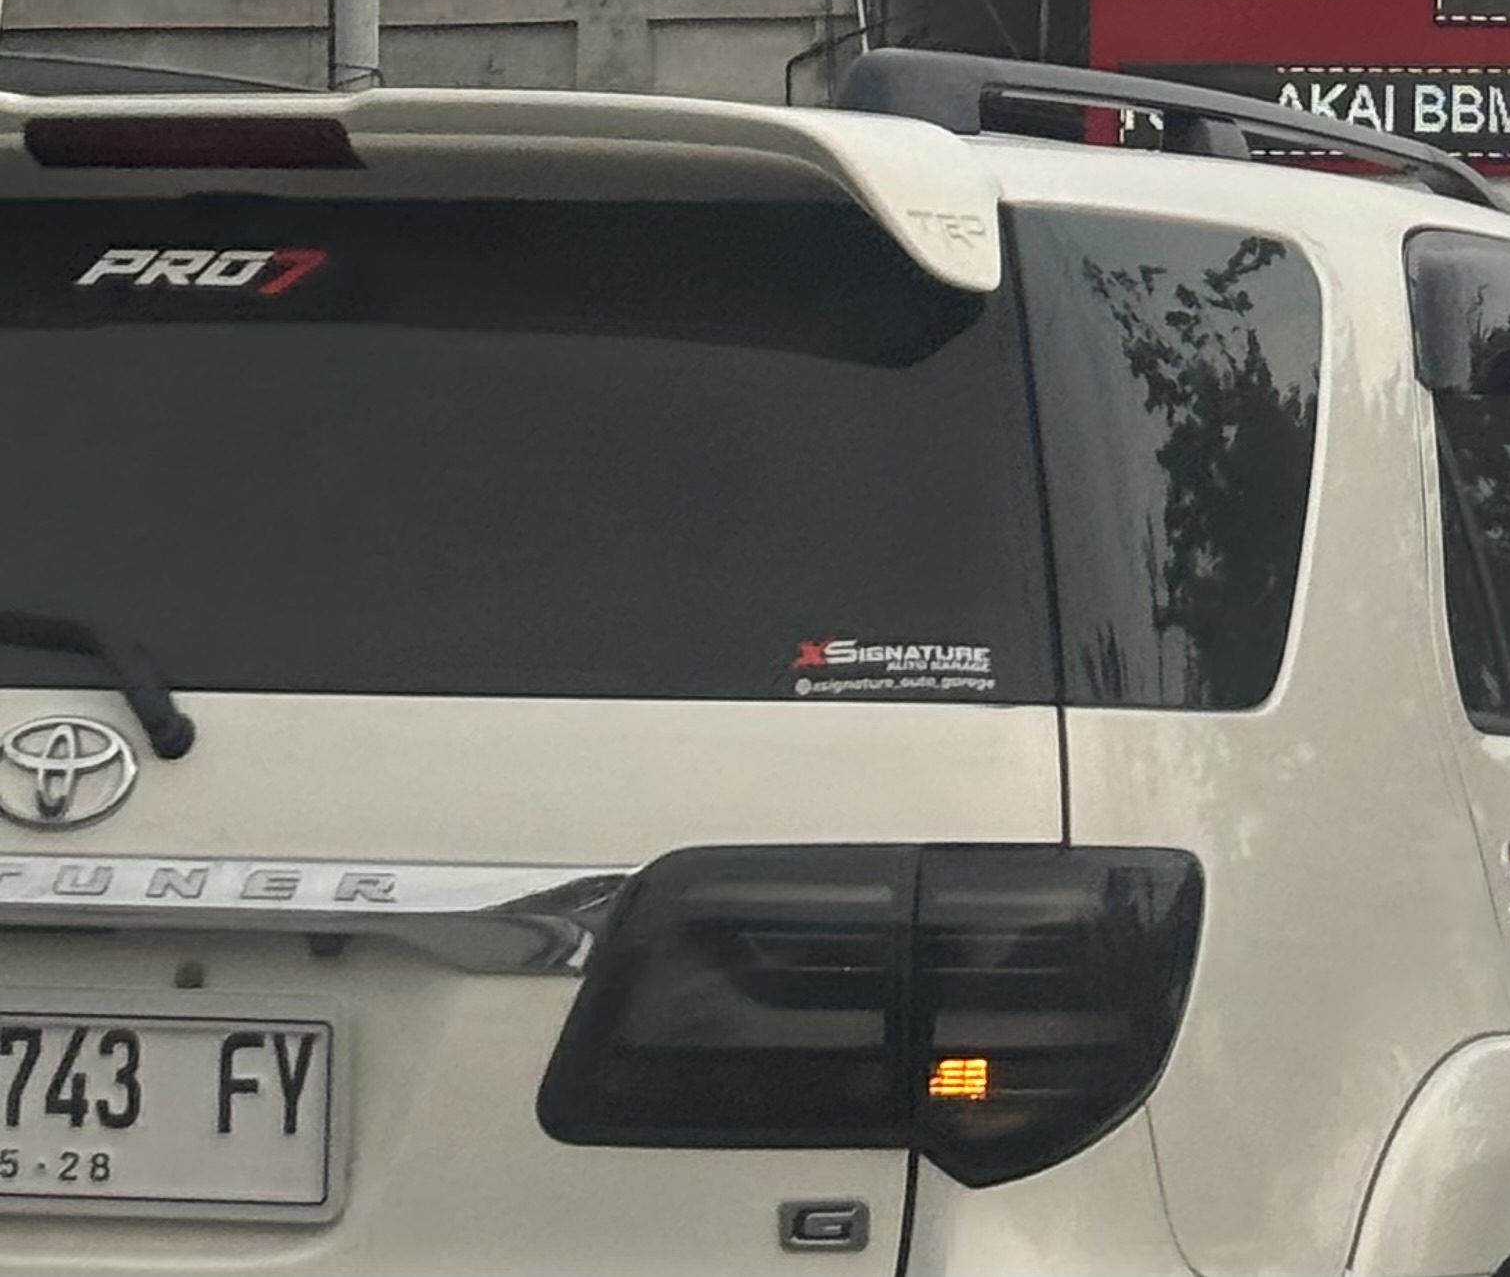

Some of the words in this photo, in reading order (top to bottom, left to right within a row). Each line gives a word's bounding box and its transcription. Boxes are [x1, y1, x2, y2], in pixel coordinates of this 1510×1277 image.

[0, 1026, 141, 1129] 743
[217, 1032, 317, 1135] FY
[790, 1208, 857, 1244] G
